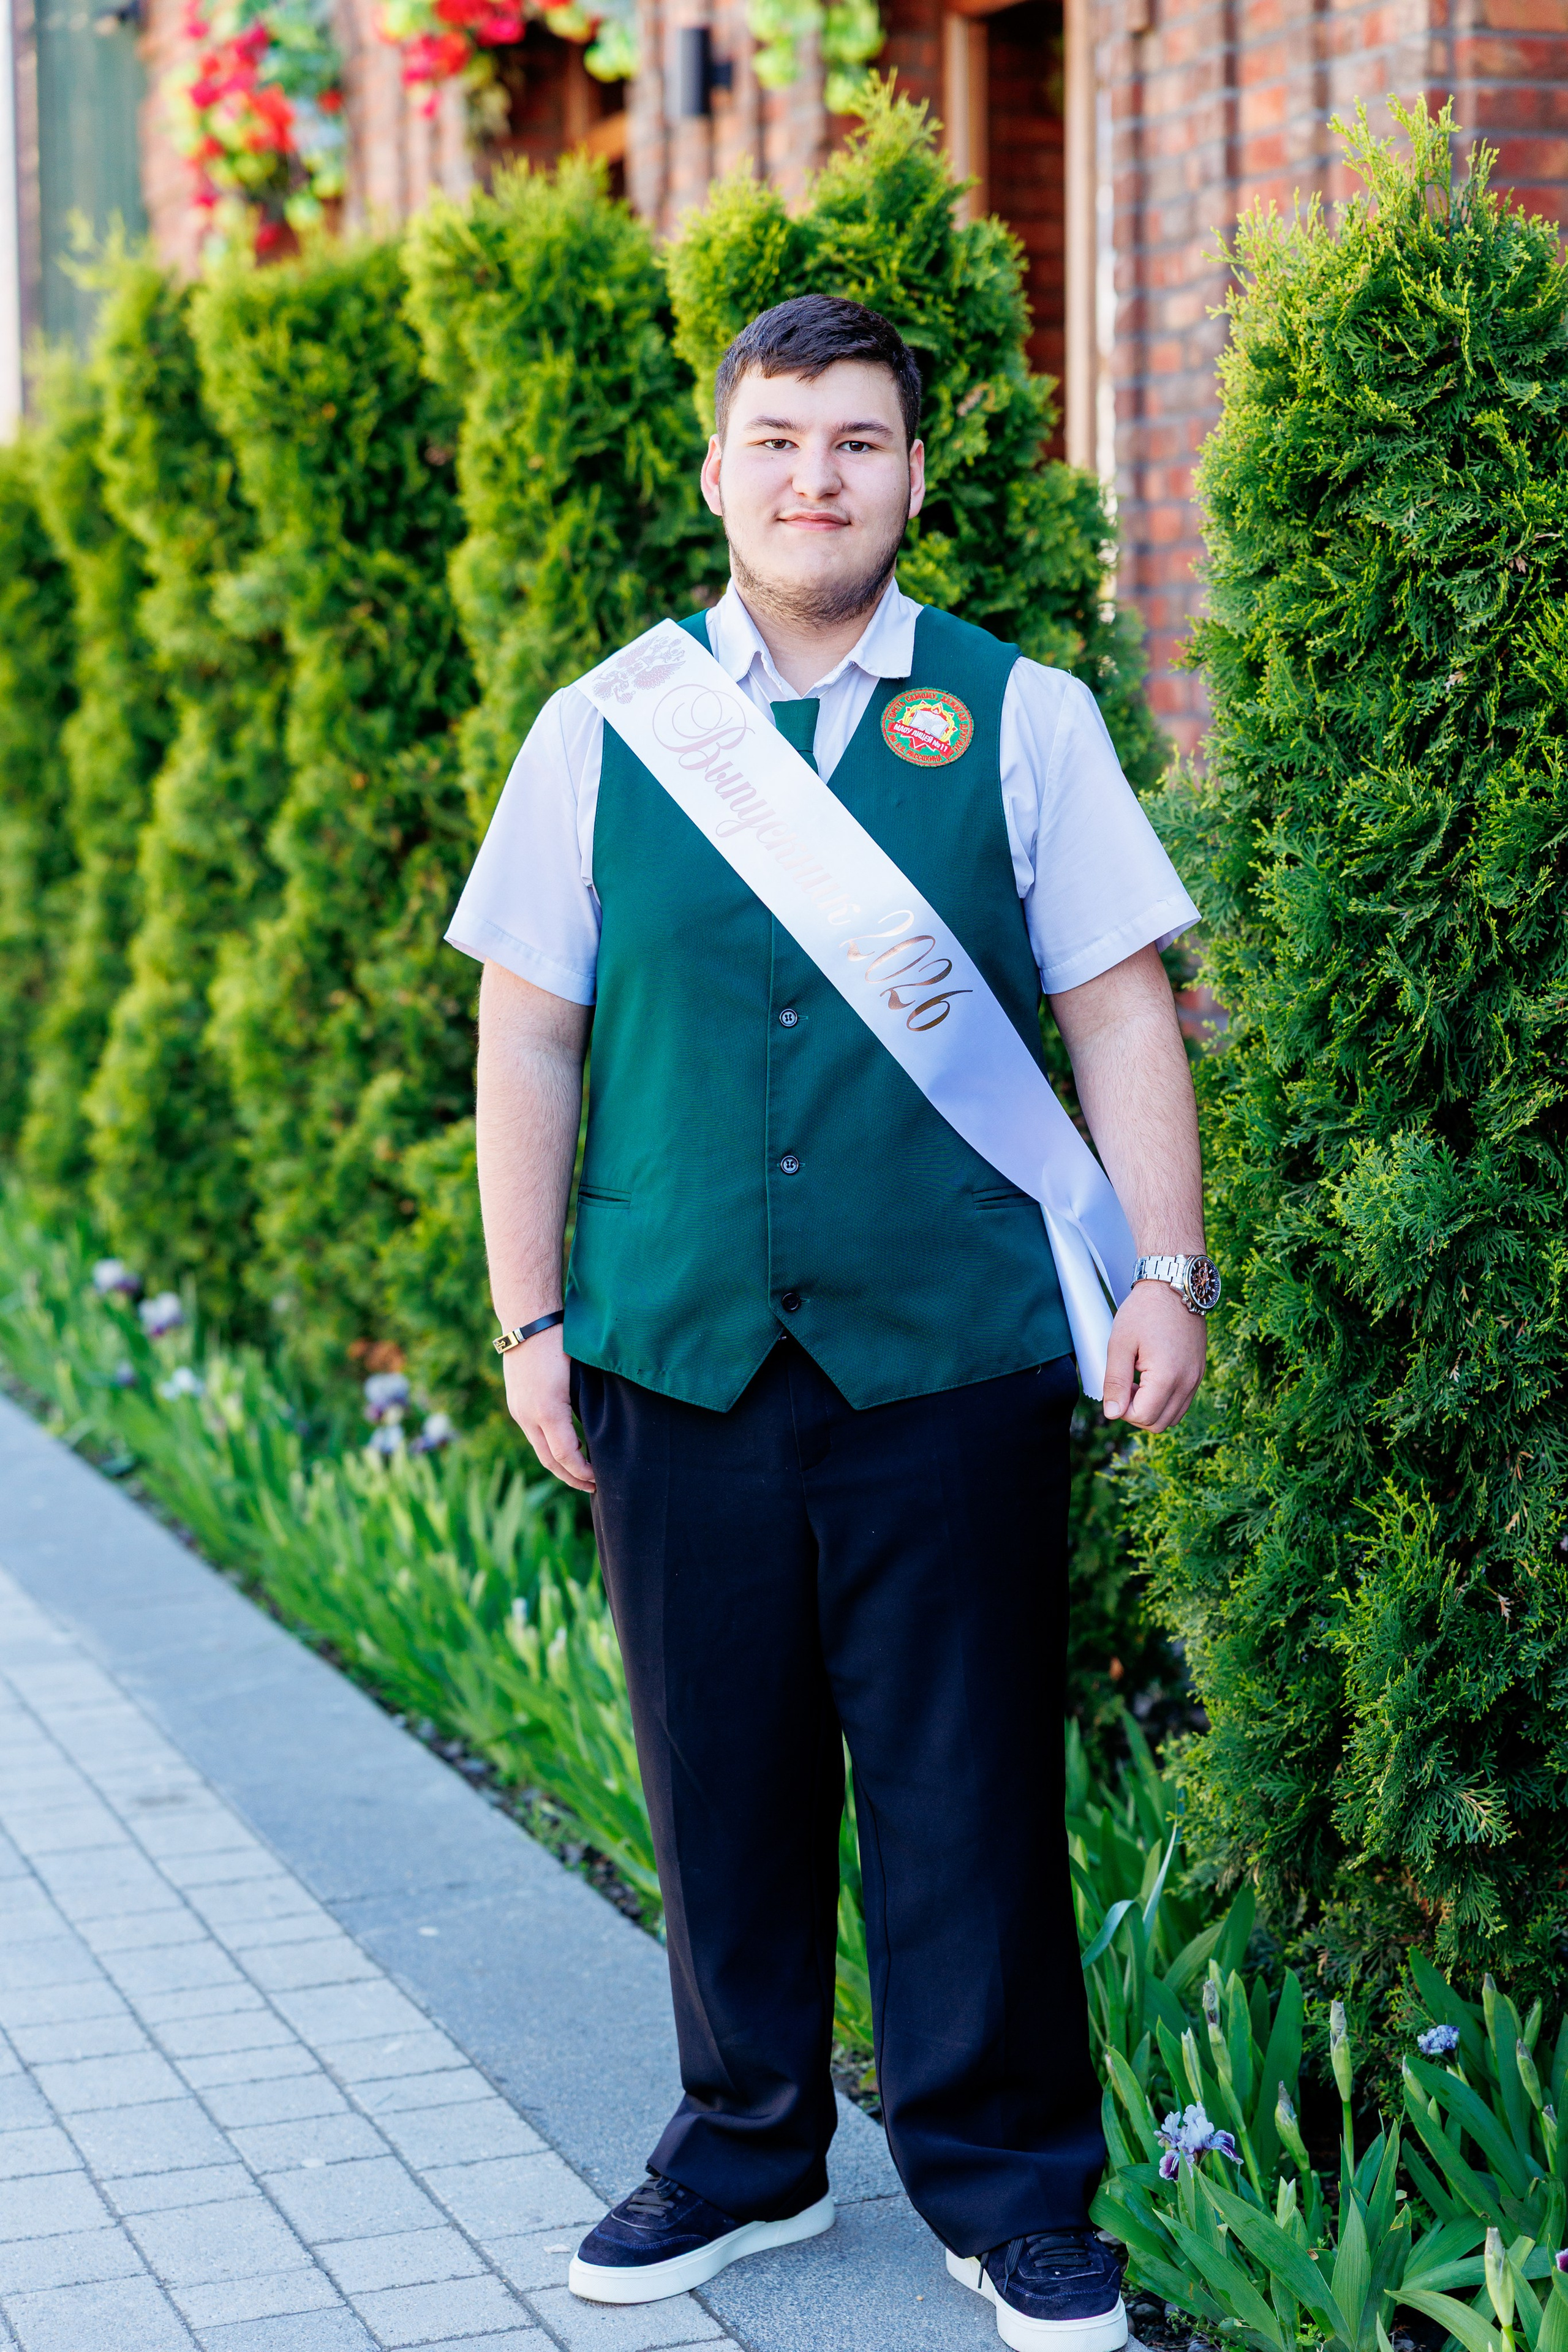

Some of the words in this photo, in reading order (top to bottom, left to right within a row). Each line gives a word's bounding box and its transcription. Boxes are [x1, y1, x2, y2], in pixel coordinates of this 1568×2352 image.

[887, 700, 906, 722] ГОРЕТЬ
[894, 723, 913, 734] МАОУ
[911, 730, 933, 744] ЛИЦЕЙ
[933, 740, 948, 752] №11
[652, 684, 861, 925] Выпускник
[839, 910, 973, 1032] 2026
